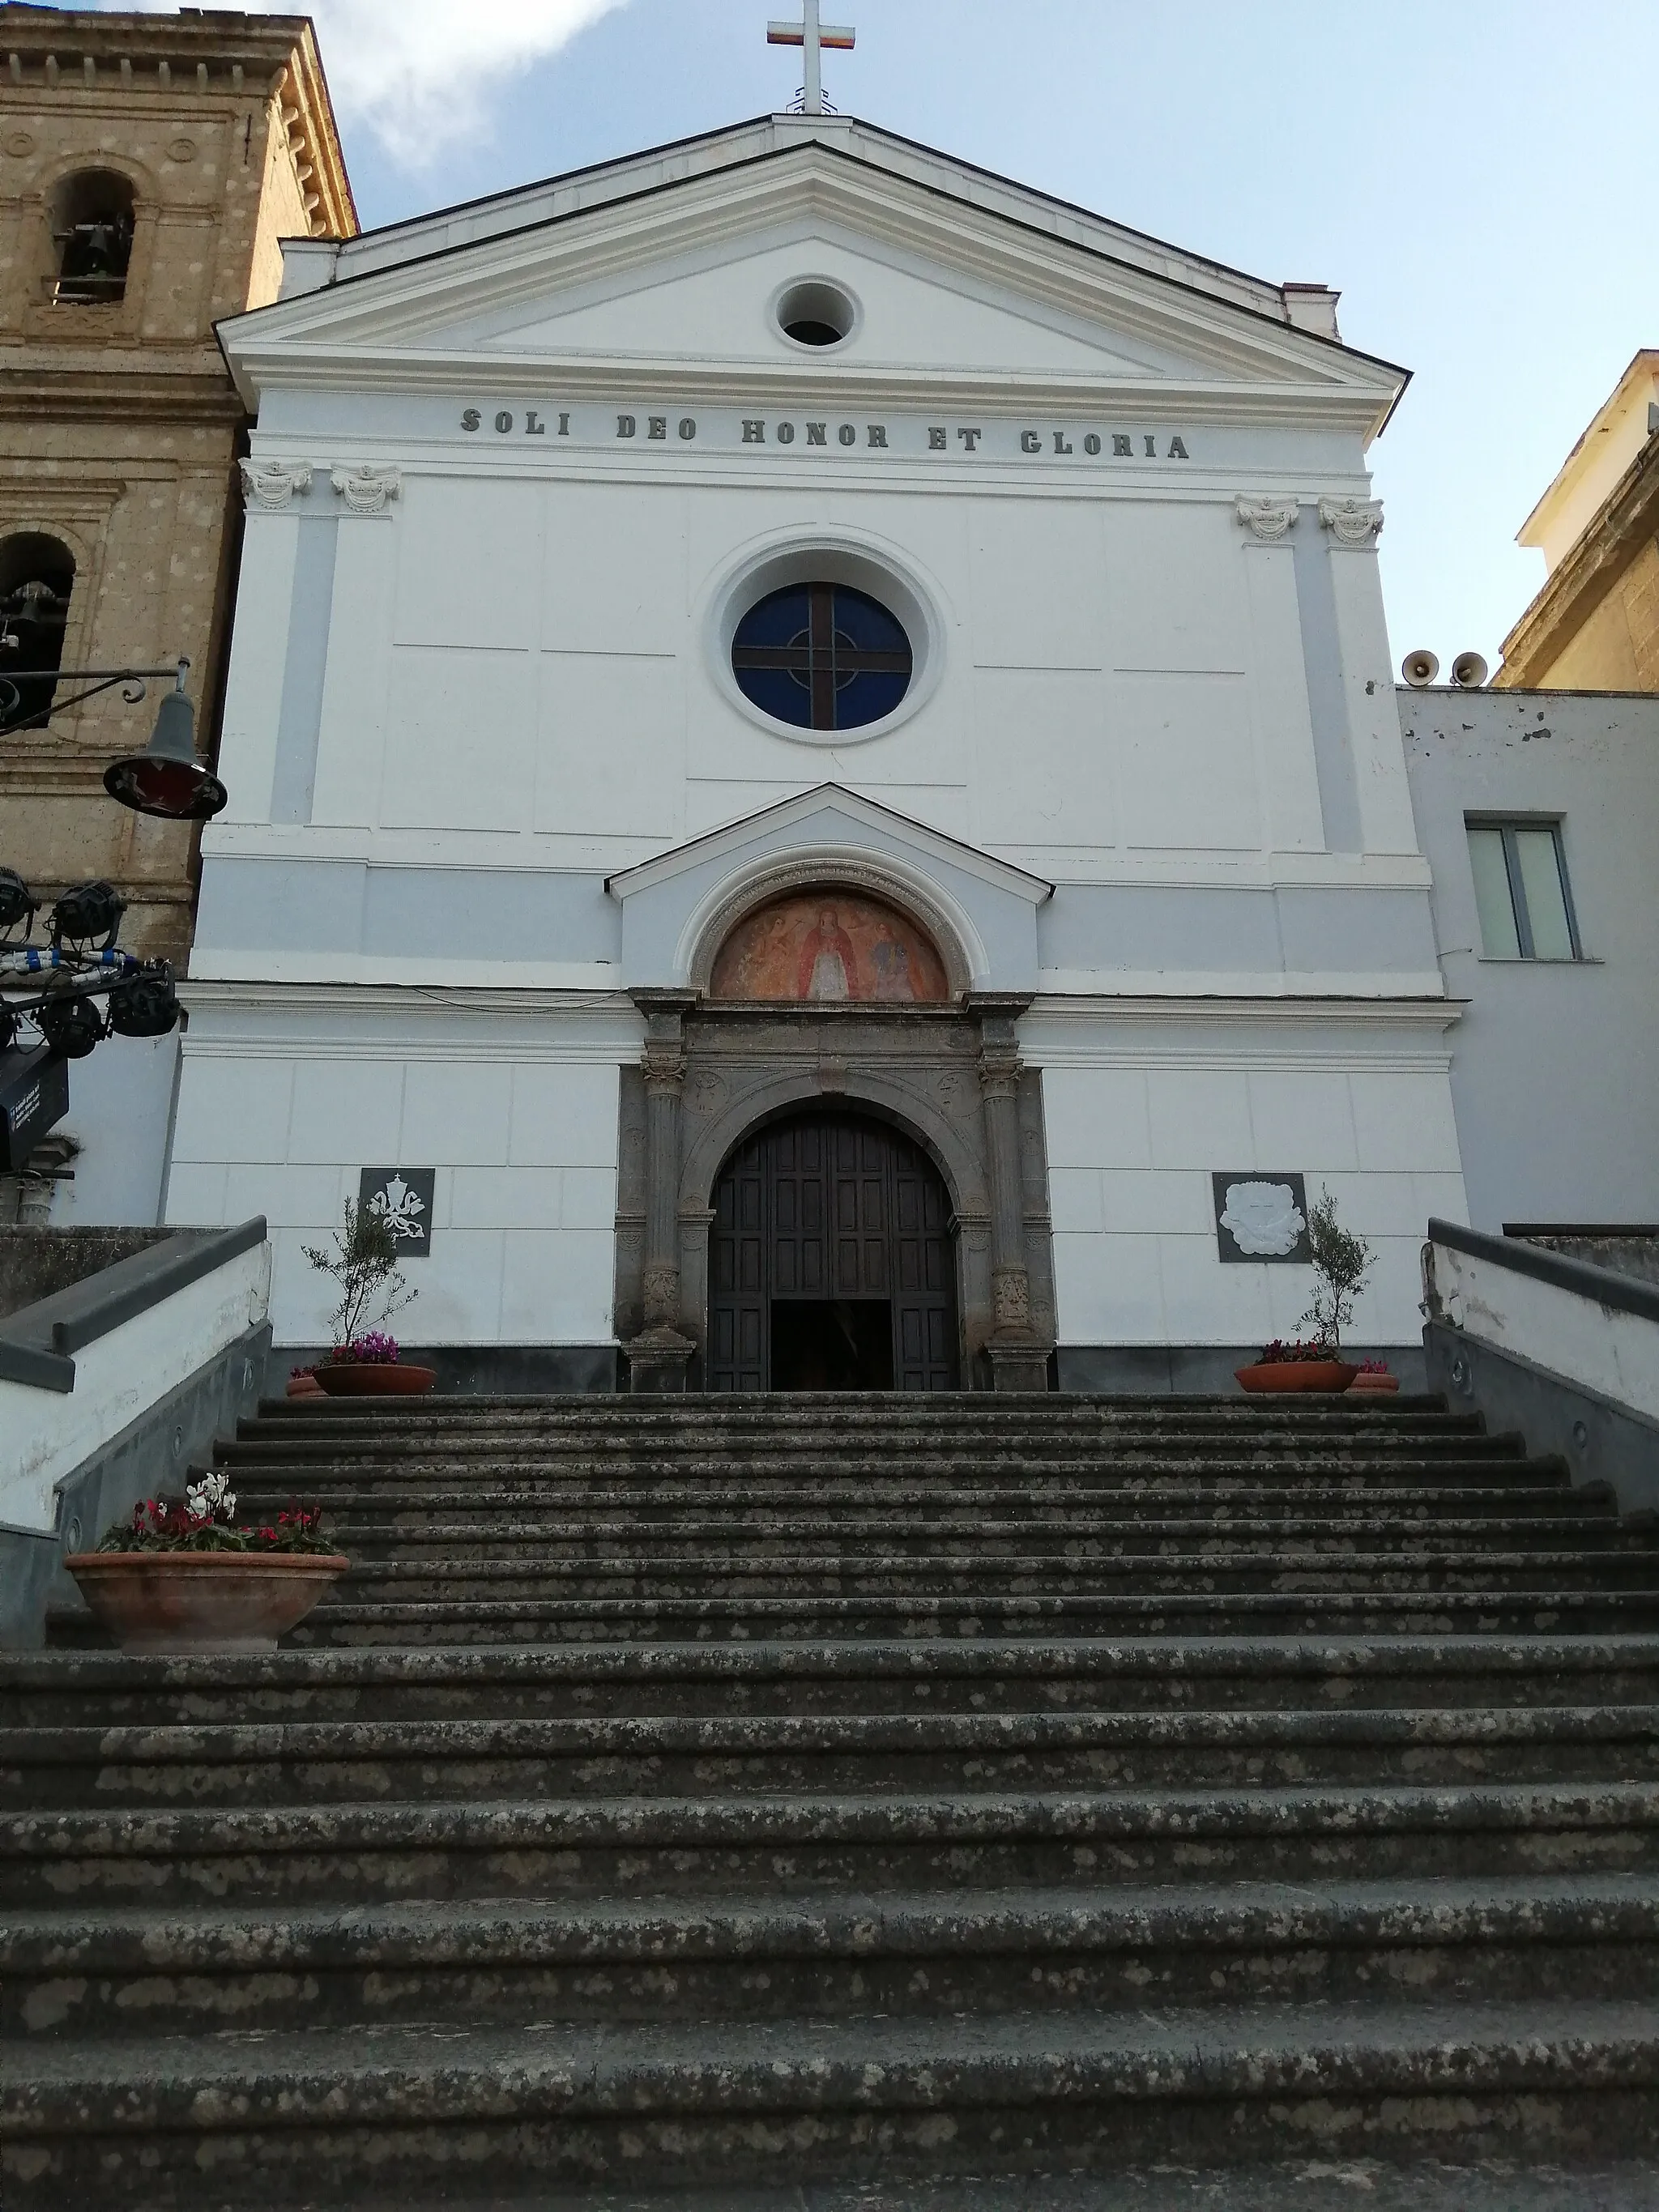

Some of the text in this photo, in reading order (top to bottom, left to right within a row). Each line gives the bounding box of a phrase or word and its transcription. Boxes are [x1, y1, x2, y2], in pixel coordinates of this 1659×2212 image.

[460, 408, 1190, 459] SOLI DEO HONOR ET GLORIA
